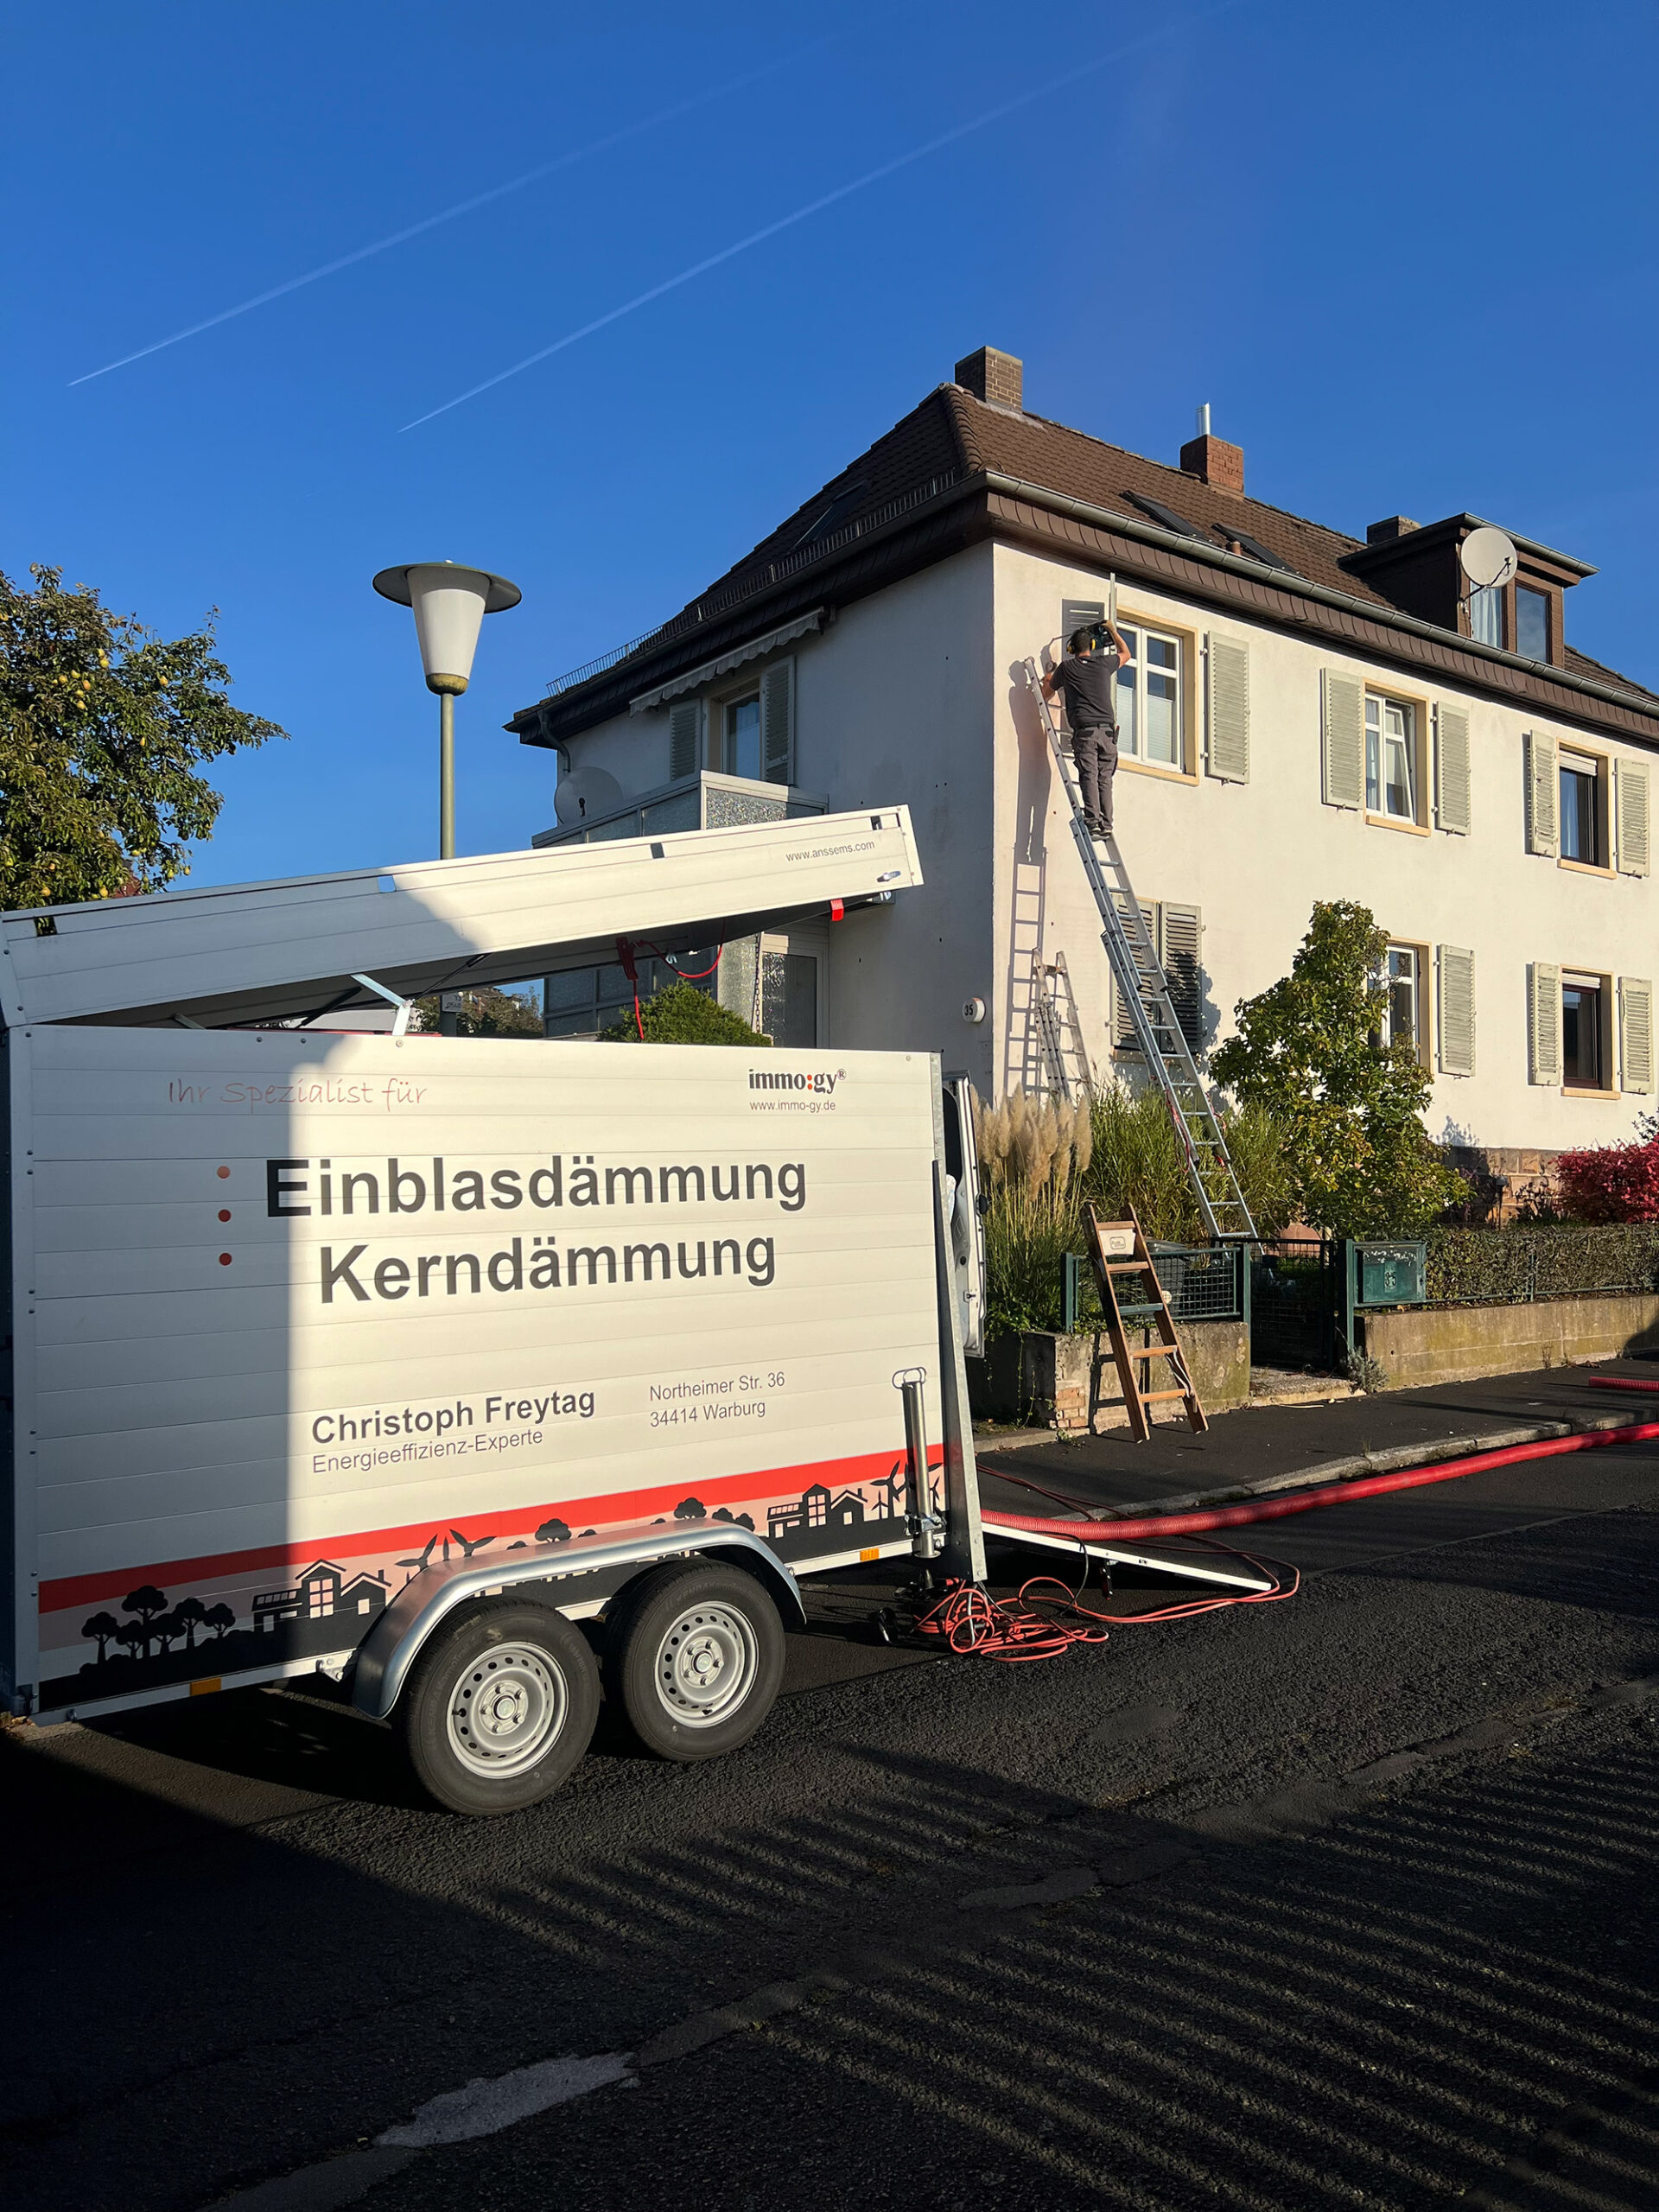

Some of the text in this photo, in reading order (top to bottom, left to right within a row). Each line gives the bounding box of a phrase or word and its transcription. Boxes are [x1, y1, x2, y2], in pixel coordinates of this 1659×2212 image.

[785, 841, 875, 862] www.anssems.com
[964, 1004, 974, 1016] 35
[168, 1077, 428, 1113] Ihr Spezialist für
[749, 1099, 836, 1112] www.immo-gy.de
[266, 1155, 806, 1217] Einblasdämmung
[321, 1236, 776, 1304] Kerndämmung
[650, 1371, 785, 1402] Northeimer Str. 36
[312, 1390, 596, 1444] Christoph Freytag
[650, 1401, 766, 1427] 34414 Warburg
[312, 1428, 543, 1474] Energieeffizienz-Experte
